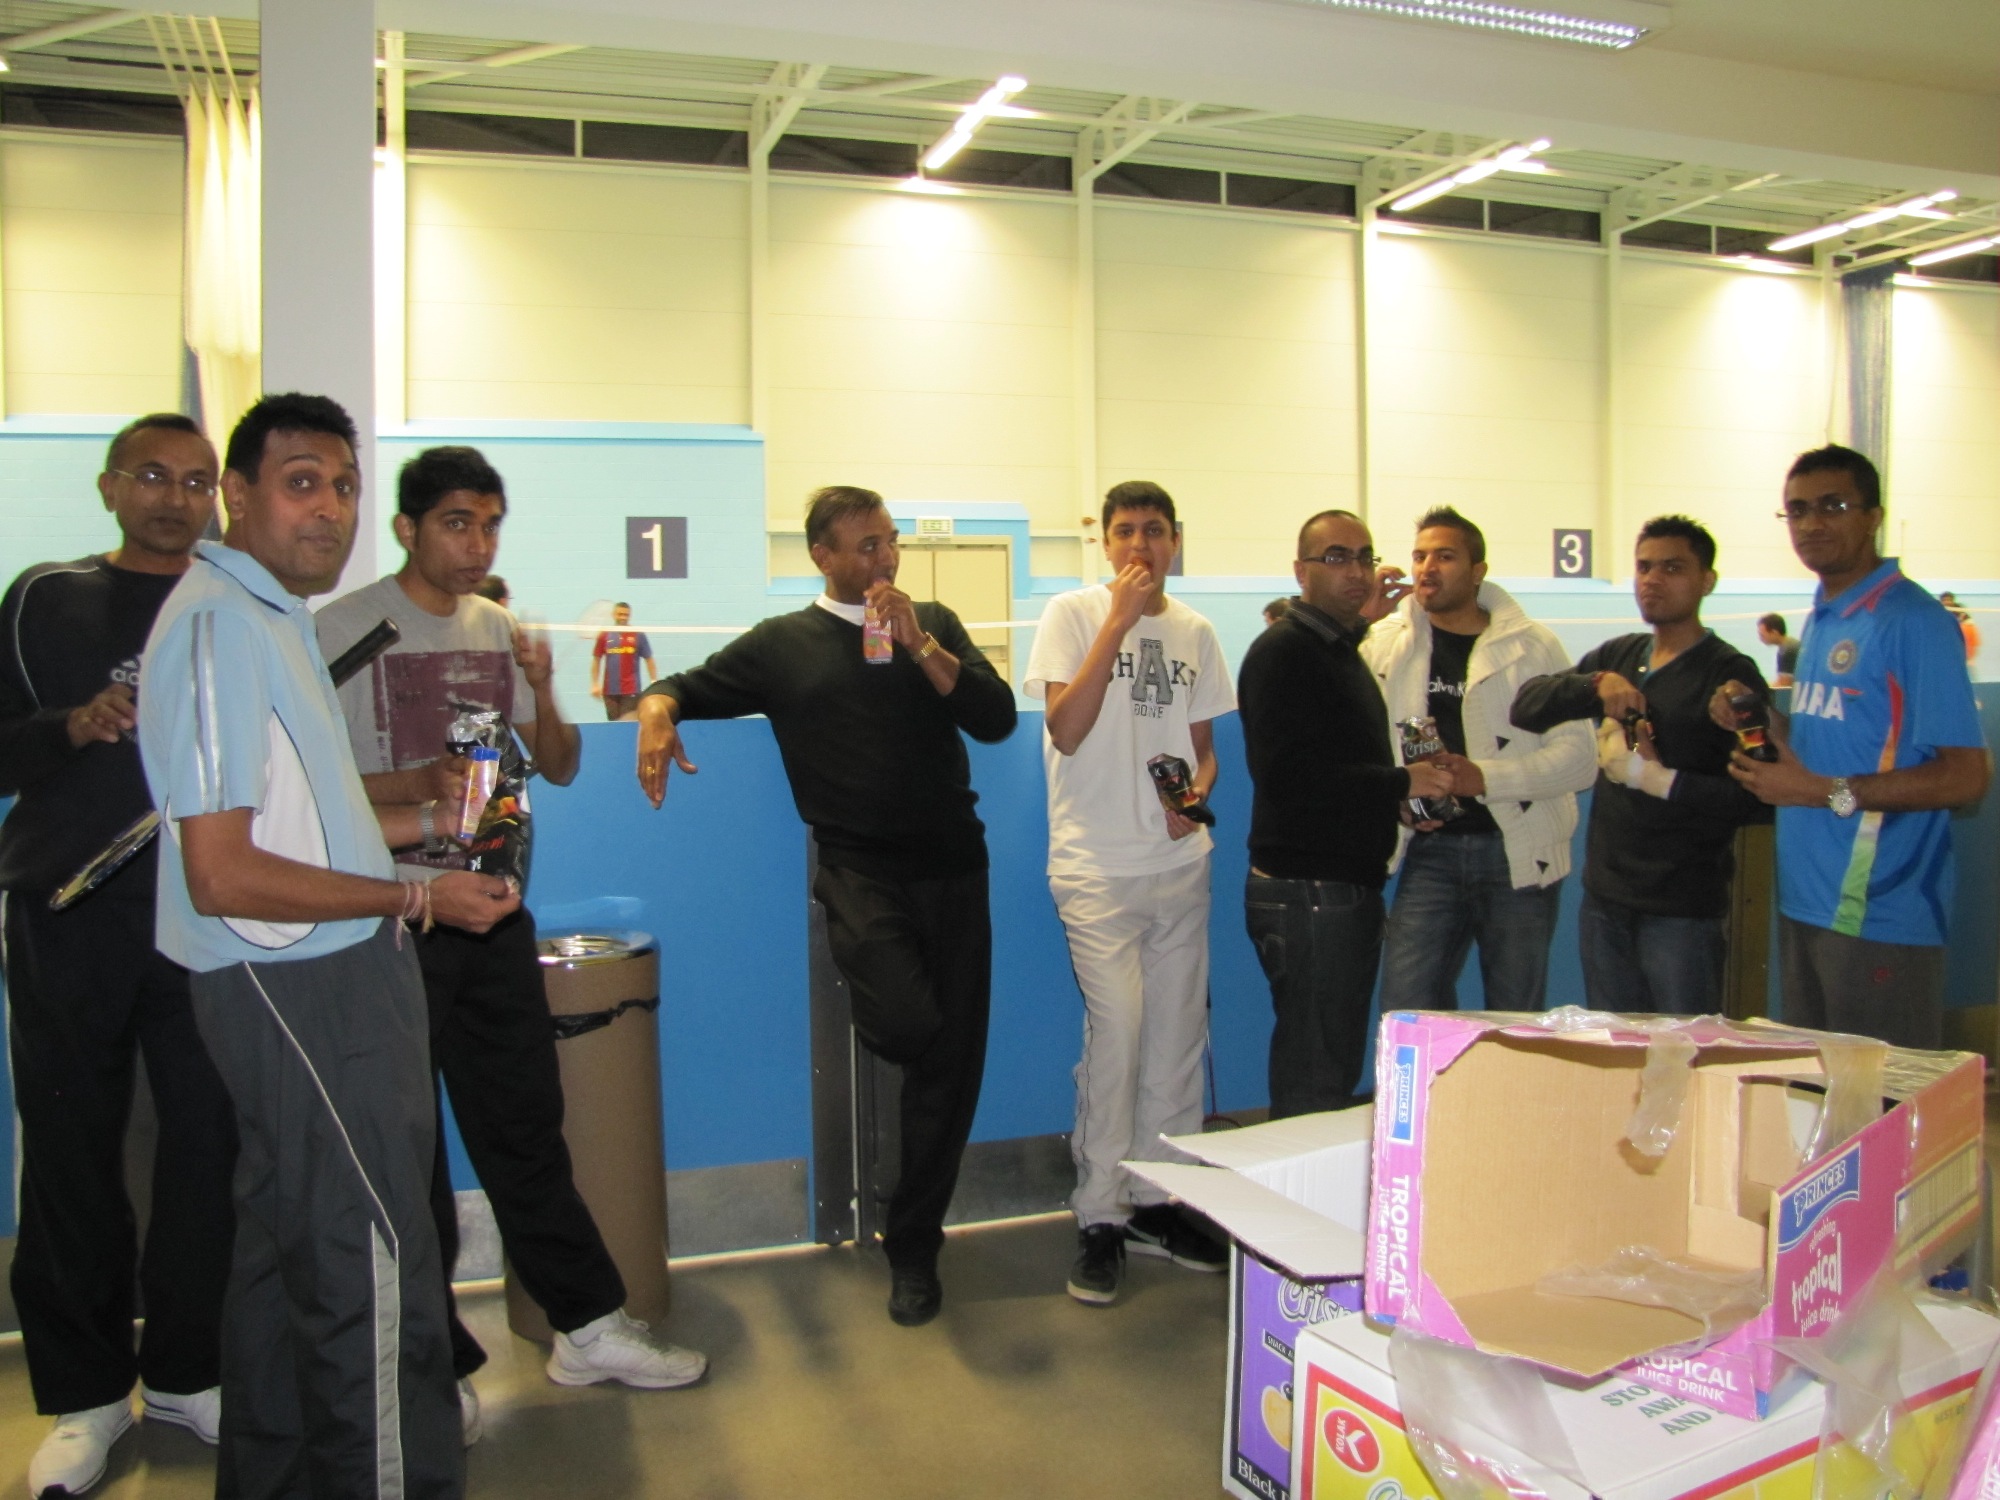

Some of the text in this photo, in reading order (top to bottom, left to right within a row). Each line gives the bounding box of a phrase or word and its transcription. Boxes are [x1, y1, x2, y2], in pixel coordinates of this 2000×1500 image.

[641, 523, 663, 571] 1
[1560, 534, 1584, 574] 3
[1394, 1062, 1412, 1123] PRINCES
[1793, 1159, 1846, 1228] PRINCES
[1376, 1233, 1388, 1282] DRINK
[1388, 1174, 1410, 1299] TROPICAL
[1791, 1231, 1842, 1324] tropical
[1267, 1335, 1287, 1355] SNACK
[1801, 1309, 1818, 1338] juice
[1637, 1366, 1725, 1403] JUICE DRINK
[1335, 1416, 1346, 1454] KOLAK
[1659, 1410, 1712, 1436] AND
[1237, 1457, 1276, 1500] Black
